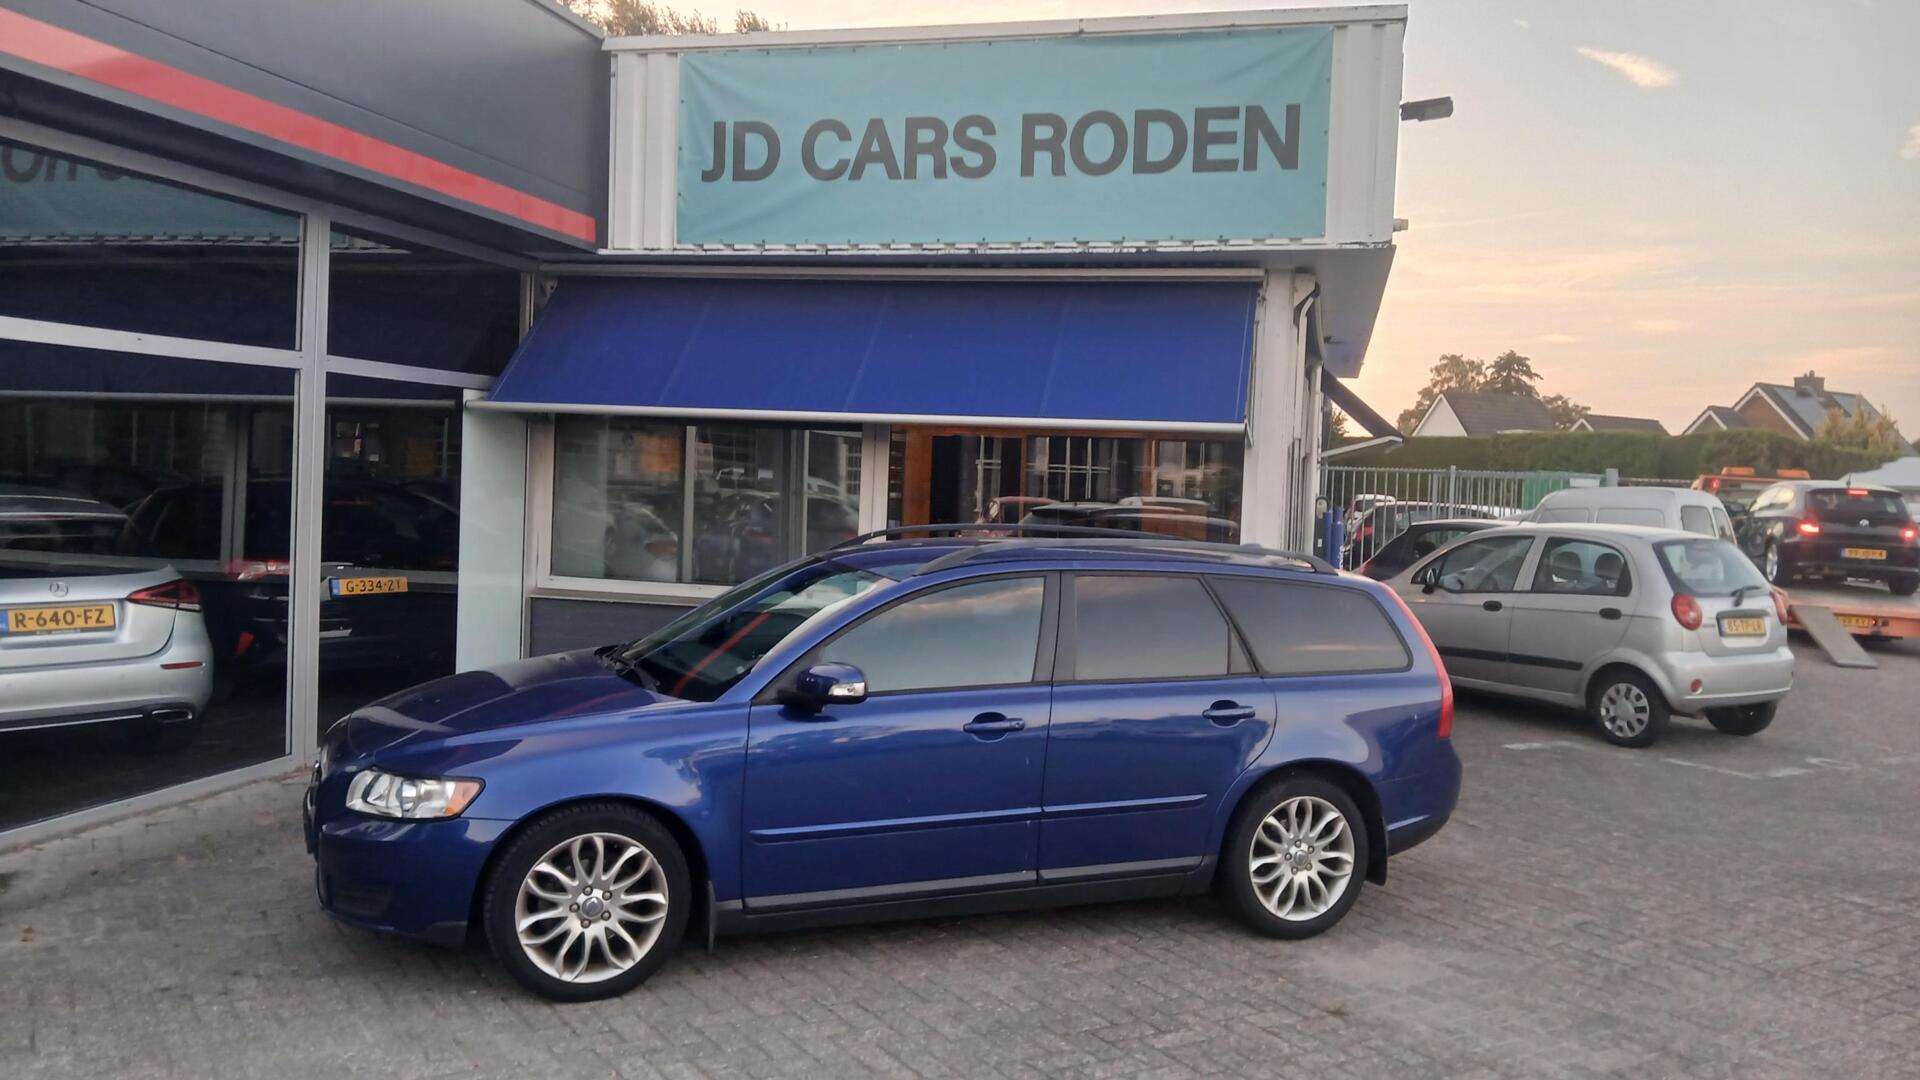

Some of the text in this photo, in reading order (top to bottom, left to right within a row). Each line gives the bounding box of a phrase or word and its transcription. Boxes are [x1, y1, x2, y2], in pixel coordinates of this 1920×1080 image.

[702, 104, 1300, 182] JD CARS RODEN
[14, 608, 105, 628] R-640-FZ
